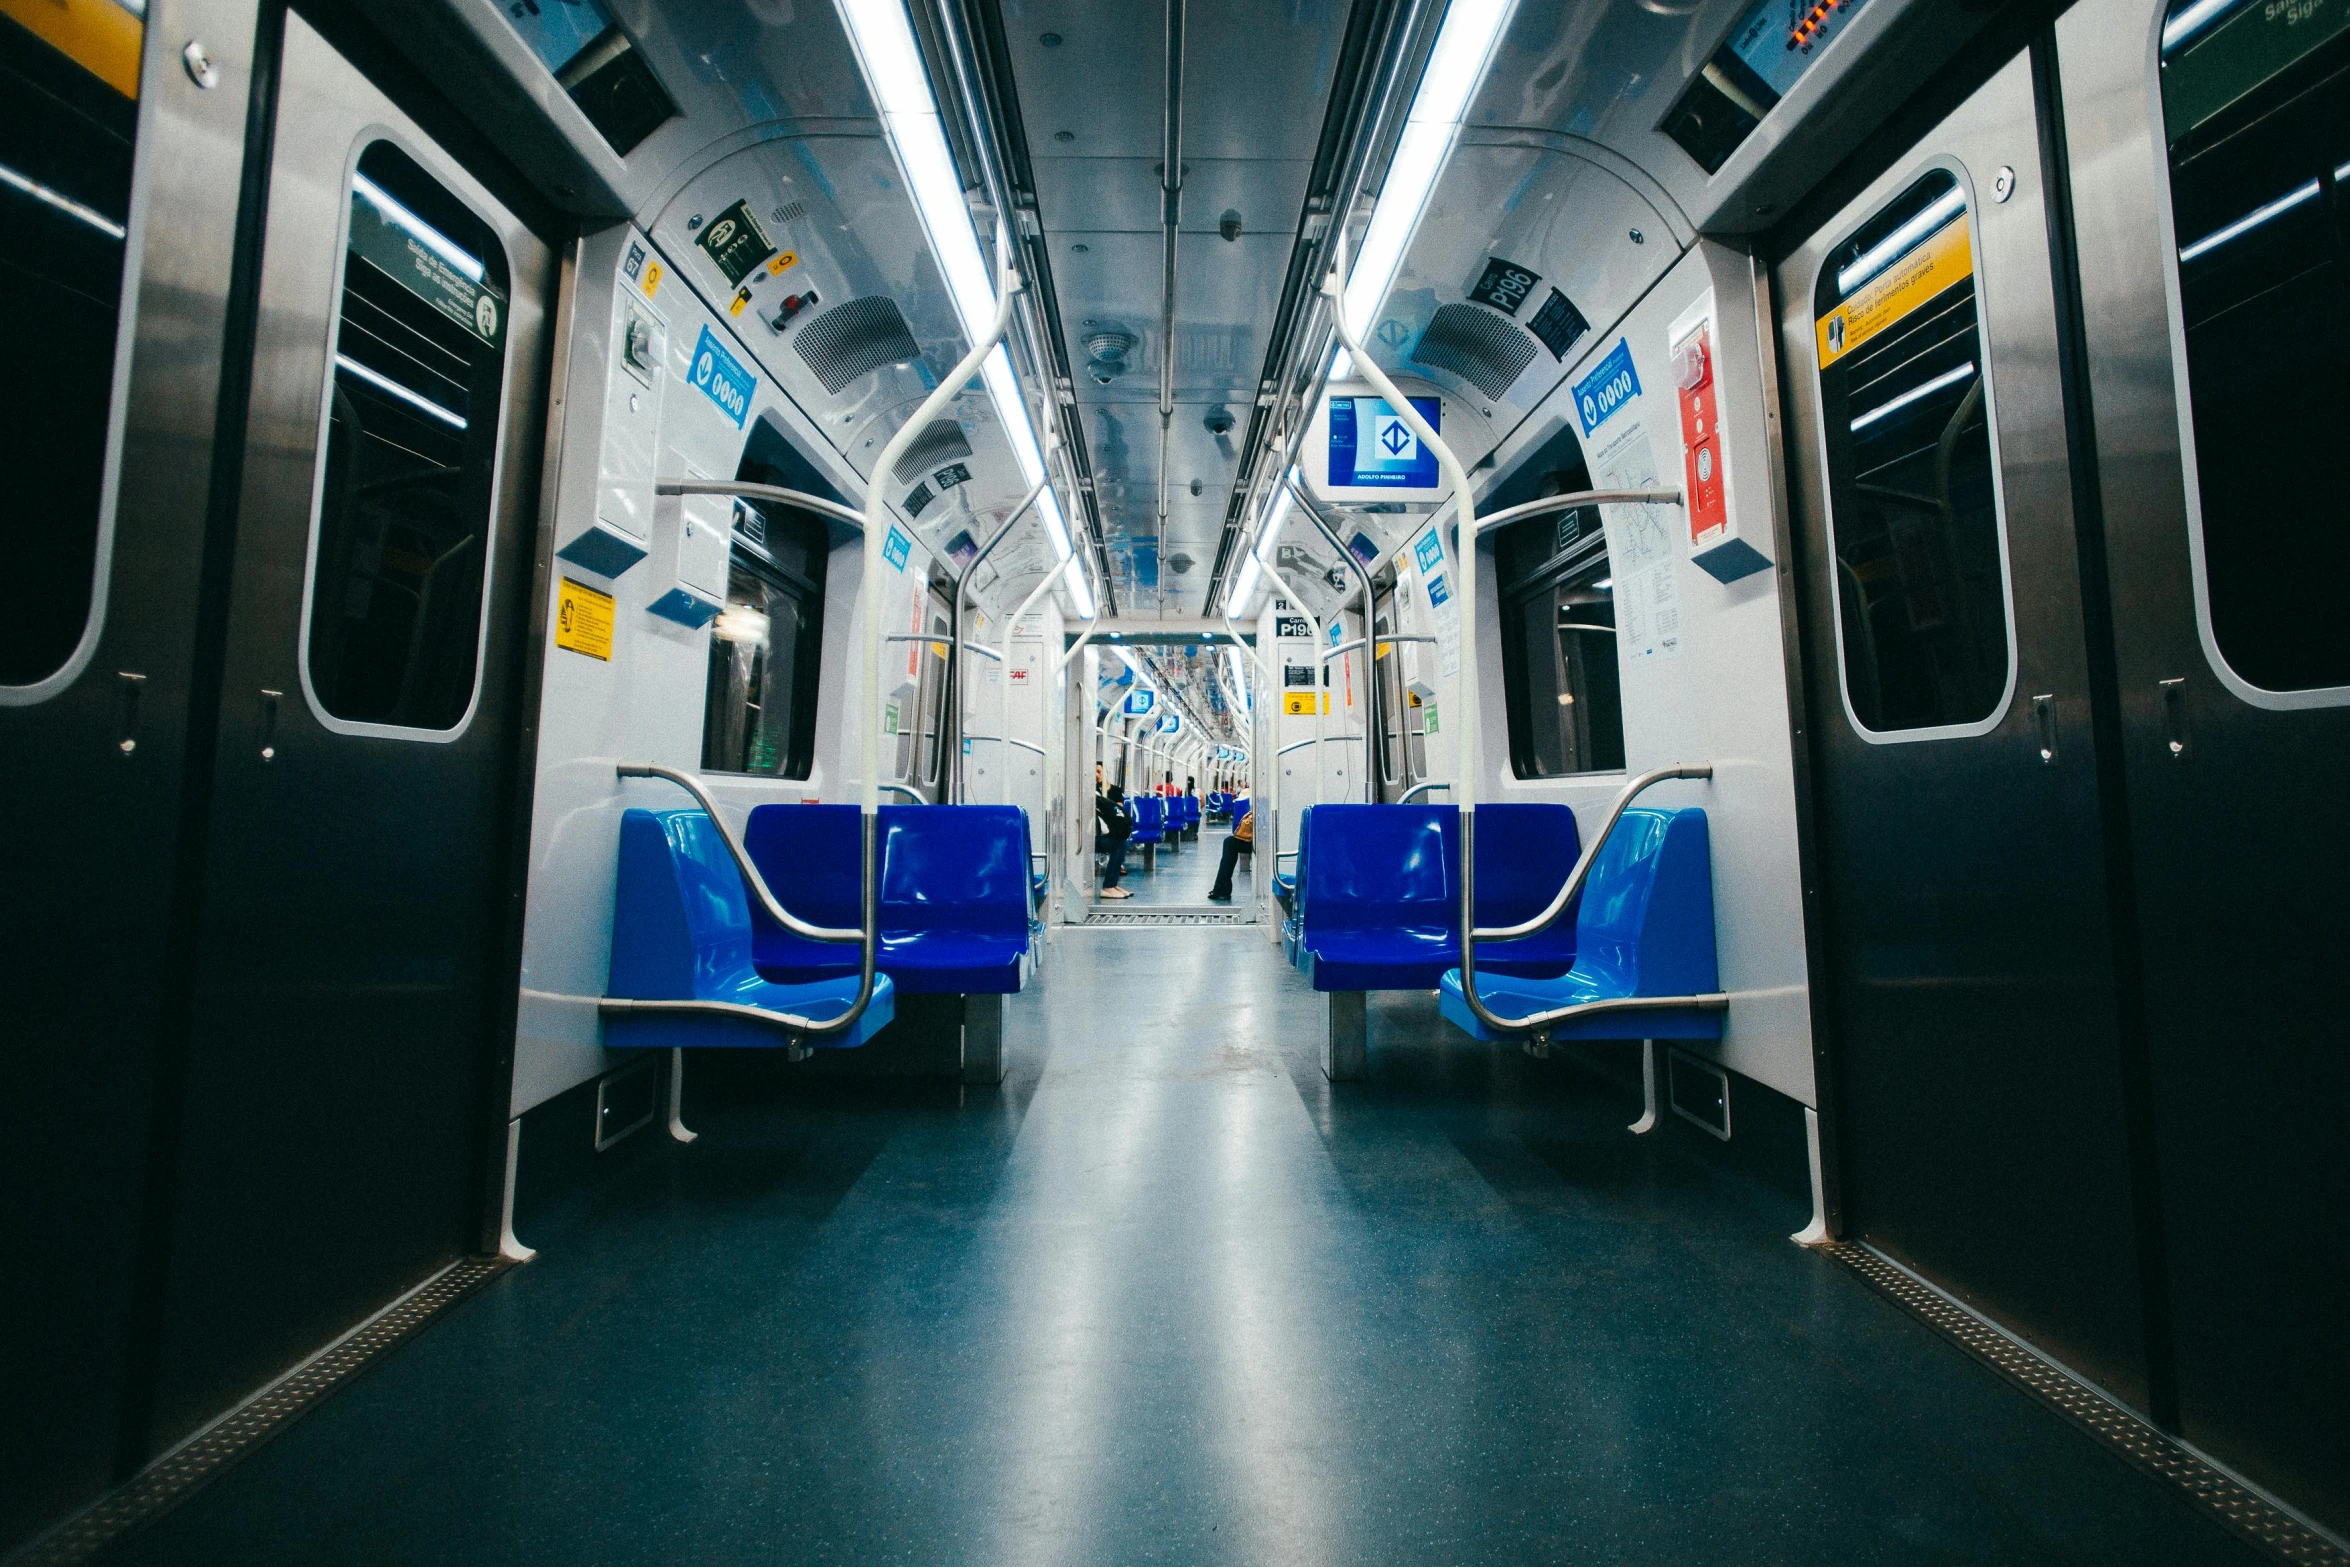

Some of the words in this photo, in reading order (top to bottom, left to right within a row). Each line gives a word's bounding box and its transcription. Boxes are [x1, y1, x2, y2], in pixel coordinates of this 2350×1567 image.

[1480, 273, 1498, 290] Carro
[1490, 269, 1532, 310] P196
[1848, 310, 1864, 326] Risco
[1866, 304, 1873, 313] de
[1875, 280, 1909, 308] ferimentos
[1911, 262, 1934, 285] graves
[1875, 280, 1892, 296] Porta
[1893, 252, 1931, 283] automática
[1590, 358, 1613, 384] Preferencial
